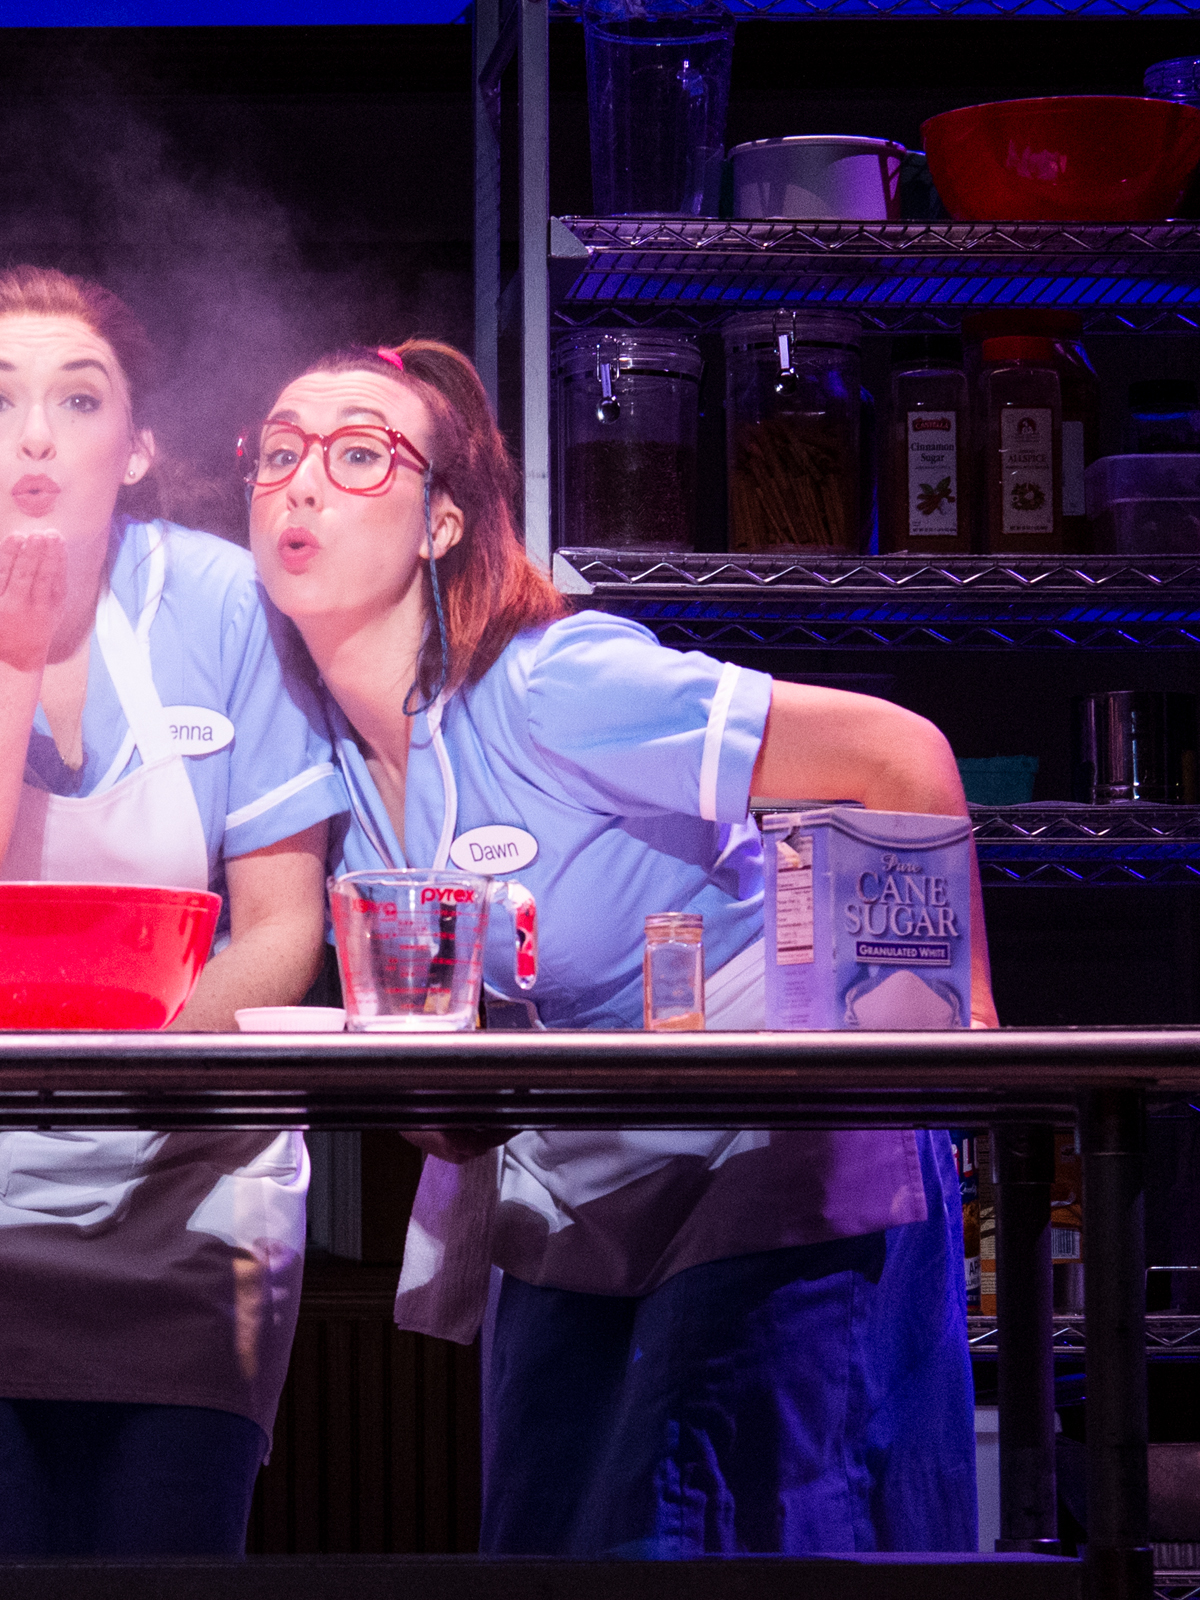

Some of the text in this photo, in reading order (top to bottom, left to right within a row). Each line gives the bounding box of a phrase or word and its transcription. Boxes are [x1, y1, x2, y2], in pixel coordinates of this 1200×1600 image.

[910, 442, 955, 451] Cinnamon
[920, 453, 945, 464] Sugar
[1008, 454, 1046, 463] ALLSPICE
[169, 724, 214, 741] enna
[469, 842, 519, 862] Dawn
[881, 853, 923, 874] Pure
[421, 887, 476, 905] pyrex
[855, 871, 950, 908] CANE
[843, 902, 959, 938] SUGAR
[859, 944, 946, 959] GRANULATED WHITE
